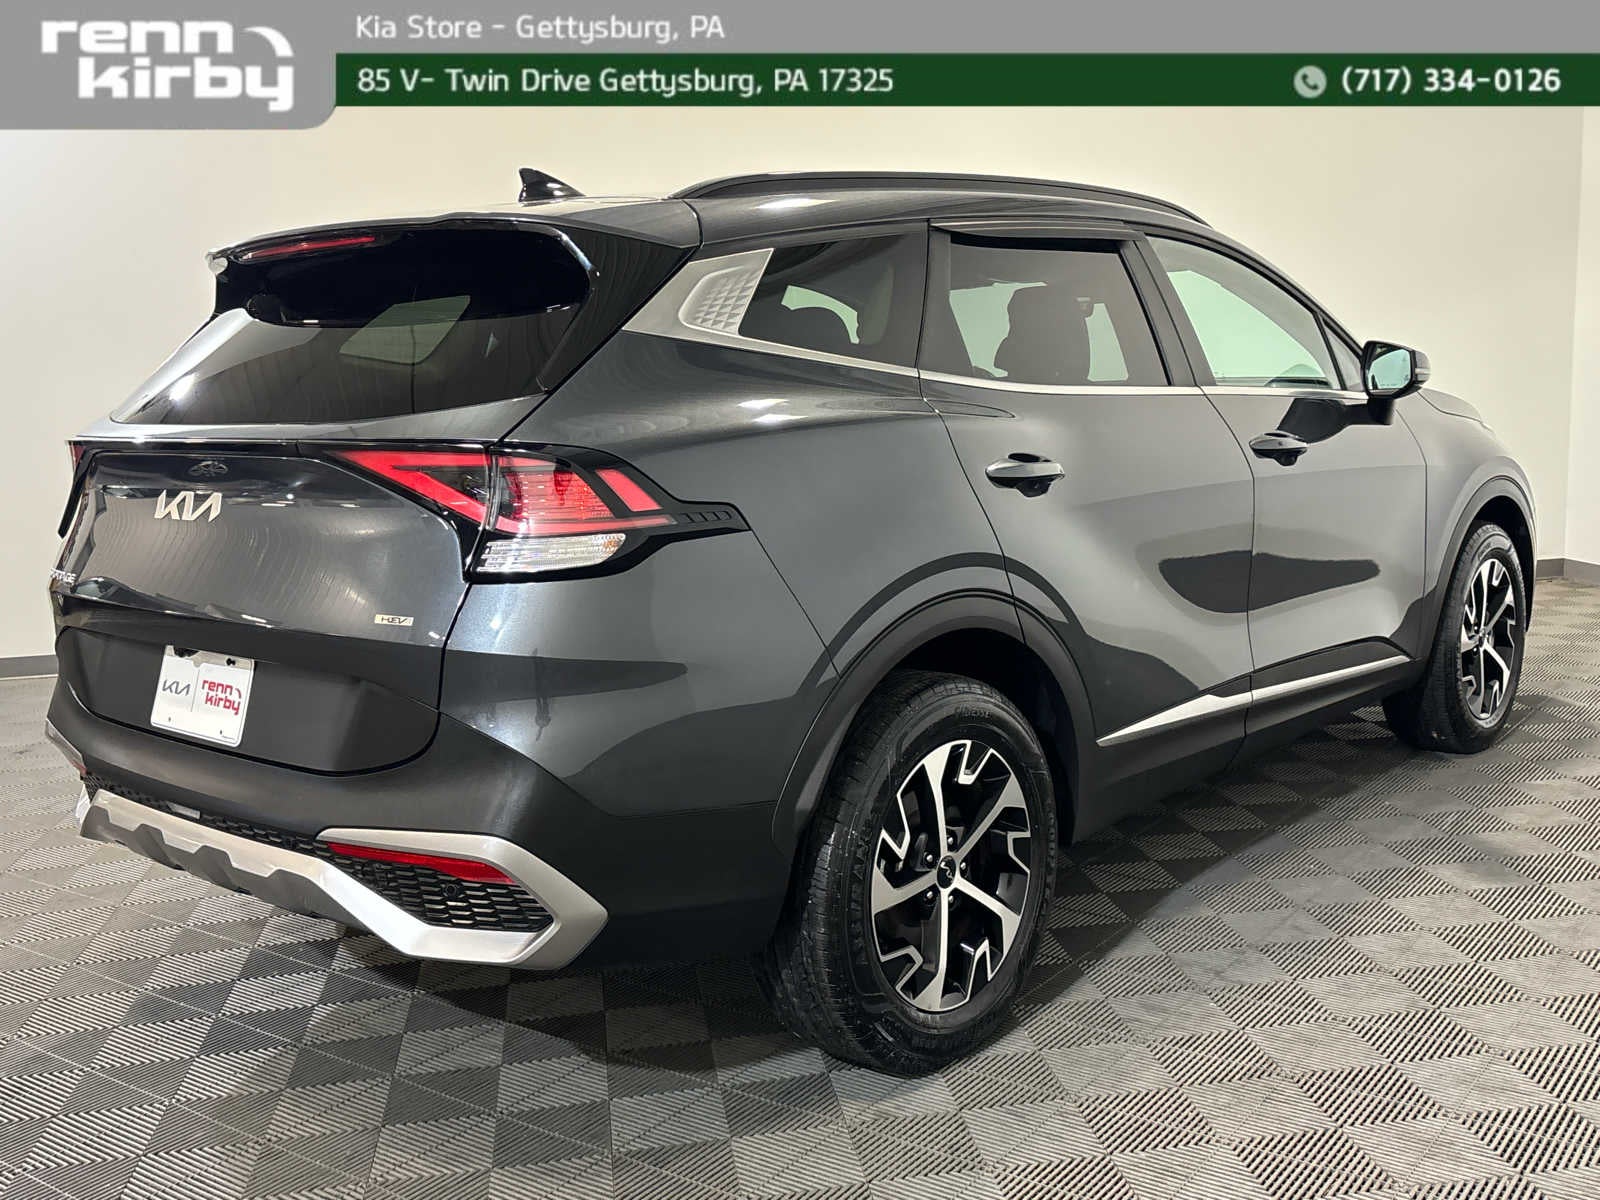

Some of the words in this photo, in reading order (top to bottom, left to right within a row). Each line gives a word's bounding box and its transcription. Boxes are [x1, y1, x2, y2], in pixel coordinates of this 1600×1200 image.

[154, 489, 223, 522] KIA
[202, 680, 234, 696] renn
[205, 692, 241, 716] kirby
